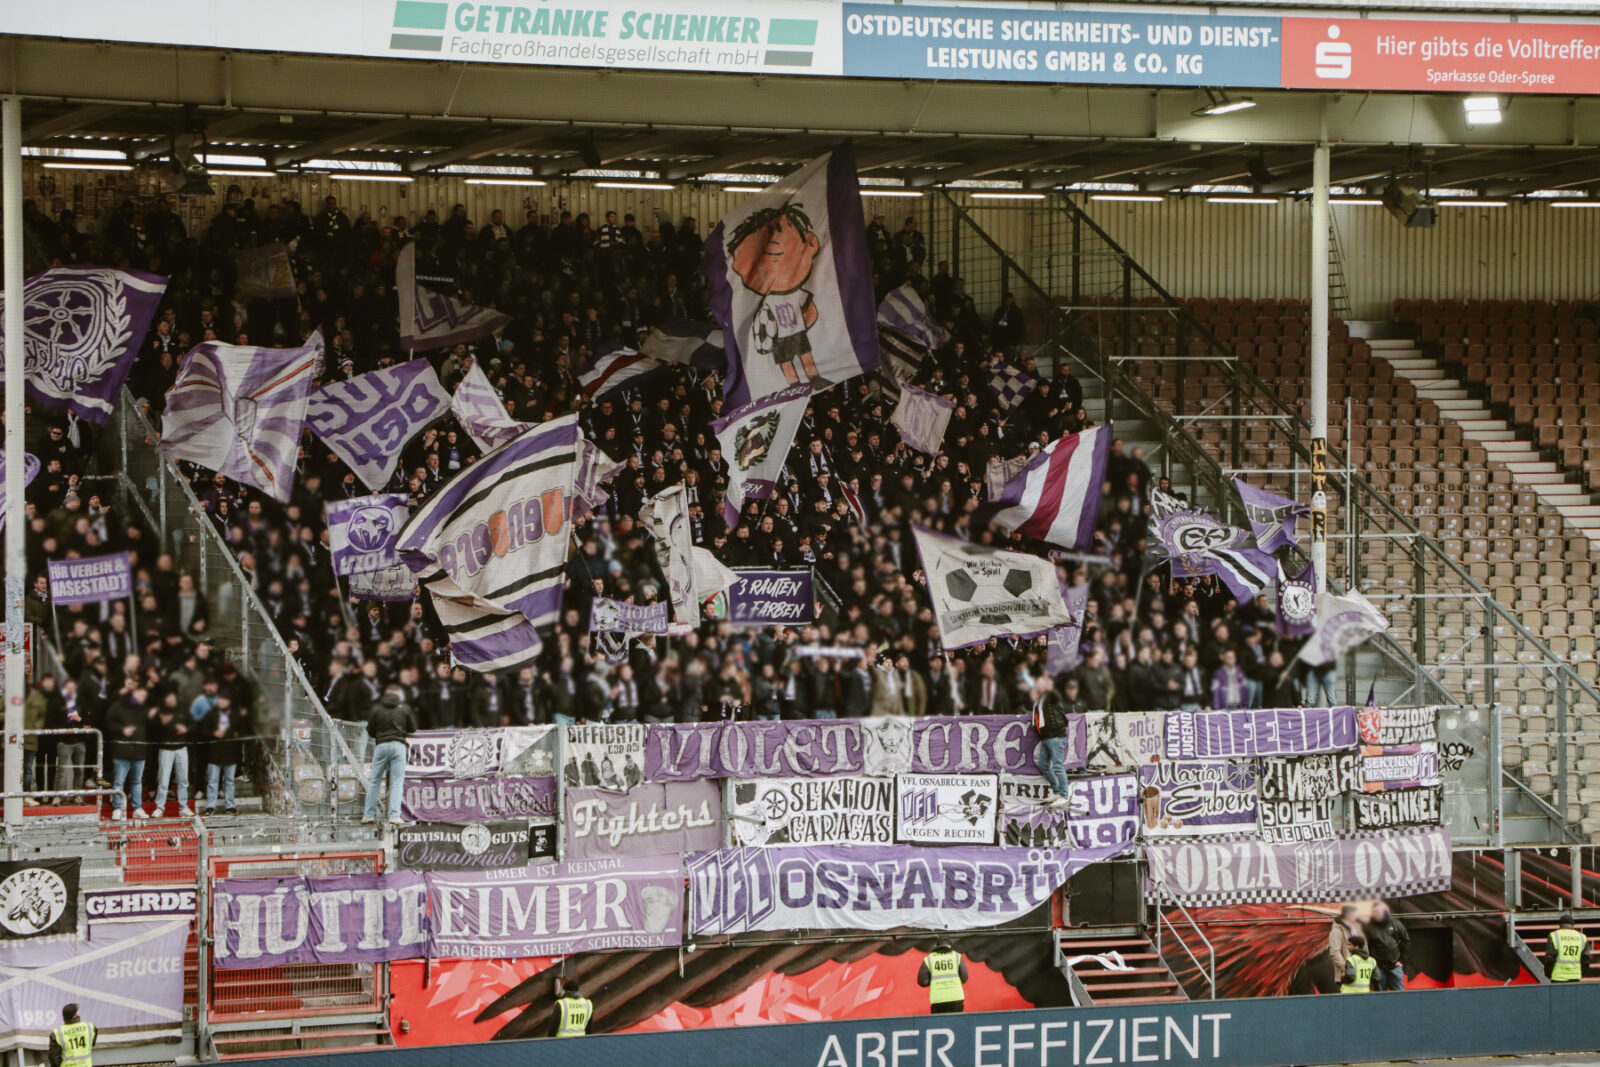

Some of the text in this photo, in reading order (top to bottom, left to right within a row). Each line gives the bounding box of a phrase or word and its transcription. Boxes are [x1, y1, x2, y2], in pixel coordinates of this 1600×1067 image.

[619, 10, 760, 44] SCHENKER
[846, 13, 1279, 48] OSTDEUTSCHE SICHERHEITS- UND DIENST-
[450, 35, 759, 66] Fachgroßhandelsgesellschaft mbH
[927, 46, 1203, 75] LEISTUNGS GMBH & CO. KG
[1376, 35, 1416, 56] Hier
[1421, 36, 1469, 61] gibts
[1474, 37, 1503, 58] die
[1426, 68, 1555, 86] Sparkasse Oder-Spree
[50, 560, 126, 580] FÜR VEREIN &
[51, 573, 129, 598] HASESTADT
[739, 577, 802, 598] 3 RAUTEN
[617, 603, 665, 620] VIOLET
[736, 600, 805, 619] 2 FARBEN
[1166, 712, 1180, 757] ULTRA
[1181, 711, 1194, 757] JUGEND
[653, 721, 862, 778] VIOLET
[1142, 761, 1225, 787] Marias
[1411, 752, 1440, 781] VFL
[789, 777, 892, 813] SEKTION
[902, 776, 991, 788] VFL OSNABRÜCK FANS
[901, 788, 939, 826] VFL
[1166, 784, 1255, 817] Erben
[573, 798, 715, 848] Fighters
[906, 828, 986, 839] GEGEN RECHTS!
[1263, 822, 1331, 844] BLEIBT!
[400, 831, 461, 843] CERVISIAM
[491, 830, 527, 845] GUYS
[401, 838, 516, 867] Osnabrück
[1154, 831, 1451, 893] FORZA VFL OSNA
[485, 858, 625, 881] EIMER IST KEINMAL
[85, 891, 196, 915] GEHRDE
[687, 847, 776, 935] VFL
[436, 878, 632, 937] EIMER
[441, 943, 507, 957] RAUCHEN
[523, 941, 574, 957] SAUFEN
[588, 934, 665, 949] SCHMEISSEN
[1563, 945, 1579, 956] 267
[935, 958, 954, 972] 466
[18, 1010, 57, 1027] 1989
[68, 1035, 87, 1051] 114
[816, 1012, 1232, 1067] ABER EFFIZIENT
